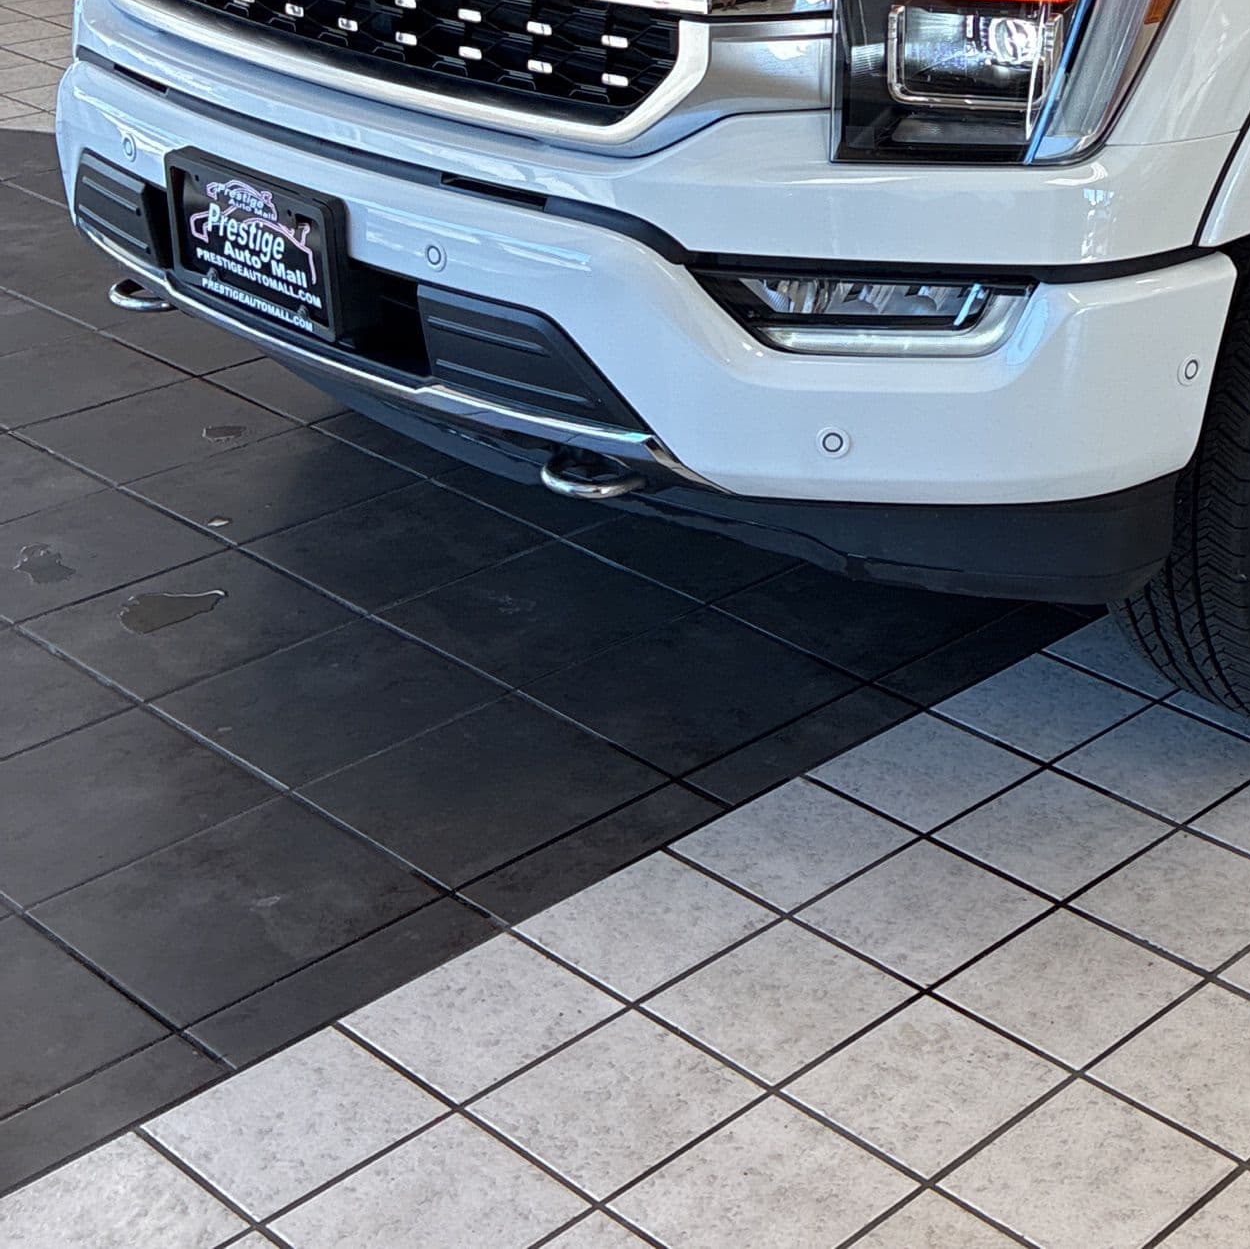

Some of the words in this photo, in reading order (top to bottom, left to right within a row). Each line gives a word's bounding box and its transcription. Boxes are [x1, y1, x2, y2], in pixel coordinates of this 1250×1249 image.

[217, 183, 265, 208] Prestige
[228, 199, 251, 212] Auto
[254, 207, 278, 221] Mall
[208, 203, 285, 263] Prestige
[196, 247, 322, 309] PRESTIGEAUTOMALL.COM
[224, 241, 262, 269] Auto
[271, 260, 308, 288] Mall
[202, 278, 314, 332] PRESTIGEAUTOMALL.COM
